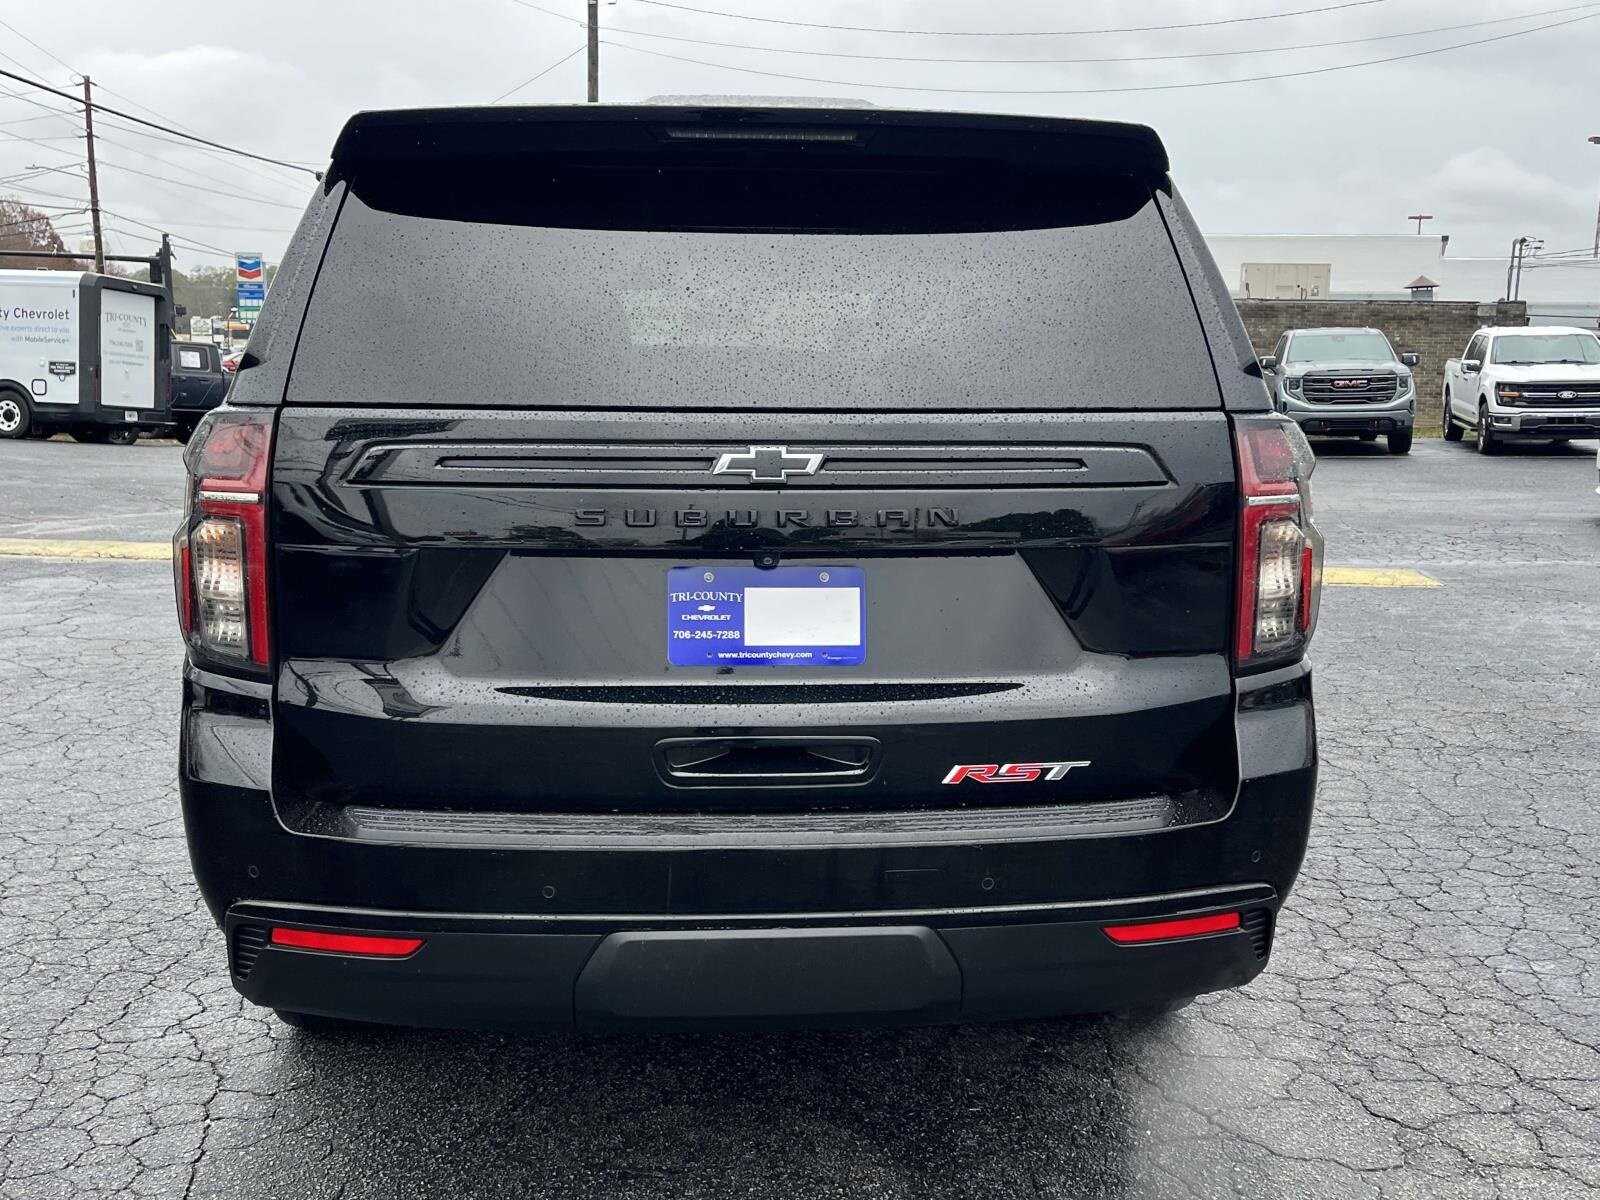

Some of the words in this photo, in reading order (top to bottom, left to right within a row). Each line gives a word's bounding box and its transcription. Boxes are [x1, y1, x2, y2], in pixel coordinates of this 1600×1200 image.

[13, 307, 70, 320] Chevrolet
[1333, 379, 1368, 388] GMC
[575, 507, 960, 528] SUBURBAN
[670, 591, 743, 602] TRI-COUNTY
[673, 630, 740, 639] 706-245-7288
[718, 651, 813, 659] www.tricountychevy.com
[941, 760, 1092, 784] RST
